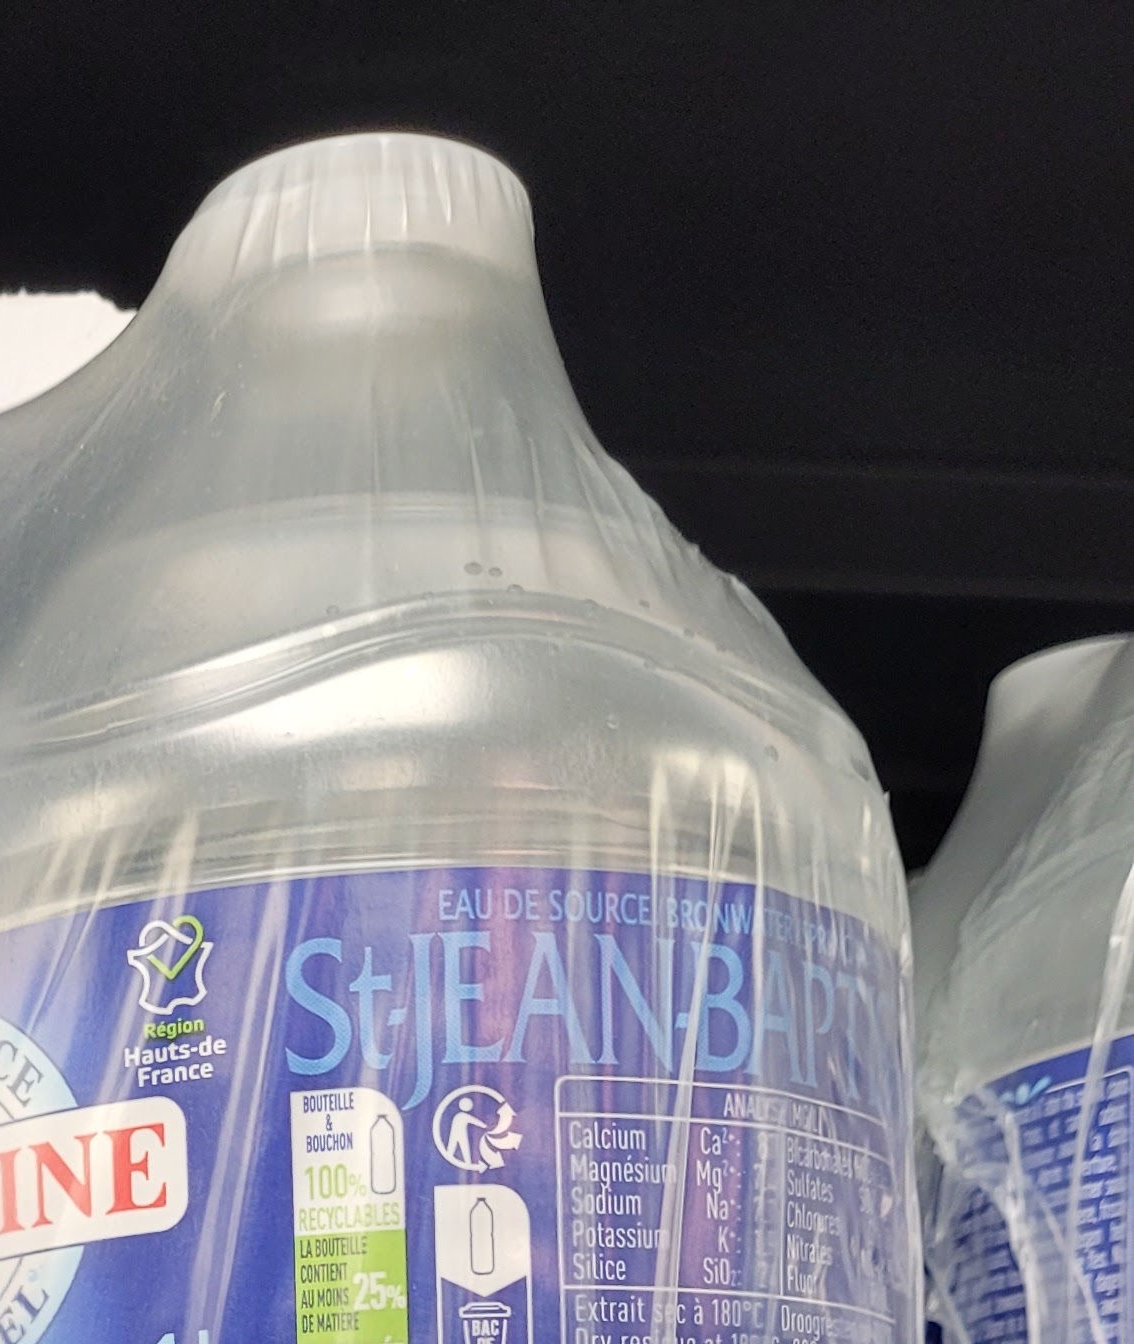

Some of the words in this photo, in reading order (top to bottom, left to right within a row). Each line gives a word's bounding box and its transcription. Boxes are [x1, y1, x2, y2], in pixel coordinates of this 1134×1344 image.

[439, 888, 492, 921] EAU
[503, 889, 539, 921] DE
[550, 890, 652, 926] SOURCE
[144, 1017, 204, 1039] Région
[124, 1035, 227, 1067] Hauts-de
[138, 1062, 214, 1087] France
[303, 1092, 354, 1113] BOUTEILLE
[325, 1114, 333, 1131] &
[569, 1121, 646, 1150] Calcium
[306, 1132, 353, 1153] BOUCHON
[305, 1163, 366, 1200] 100%
[570, 1153, 677, 1189] Magnésium
[571, 1183, 642, 1215] Sodium
[787, 1170, 834, 1203] Sulfates
[299, 1203, 400, 1231] RECYCLABLES
[300, 1239, 313, 1259] LA
[315, 1236, 367, 1257] BOUTEILLE
[787, 1233, 834, 1266] Nitrates
[300, 1263, 348, 1284] CONTIENT
[573, 1253, 626, 1281] Silice
[301, 1290, 315, 1309] AU
[317, 1287, 349, 1308] MOINS
[352, 1271, 407, 1312] 25%
[302, 1314, 315, 1334] DE
[317, 1307, 359, 1332] MATIÈRE
[575, 1295, 646, 1323] Extrait
[693, 1298, 704, 1326] à
[472, 1319, 499, 1337] BAC
